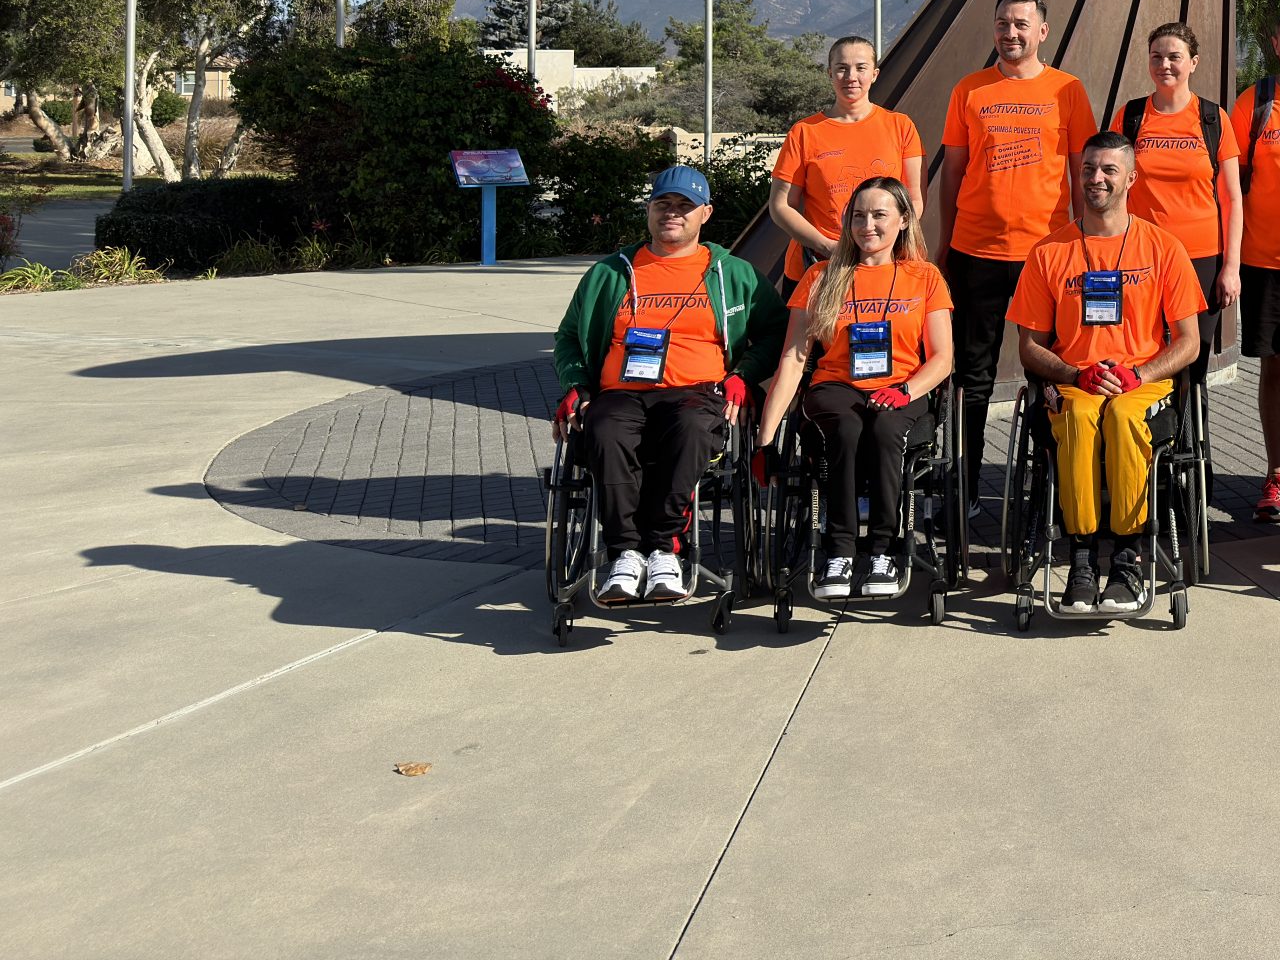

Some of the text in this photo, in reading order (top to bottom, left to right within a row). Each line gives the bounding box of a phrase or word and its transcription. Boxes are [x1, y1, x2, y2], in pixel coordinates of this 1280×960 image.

[979, 105, 1043, 115] MOTIVATION
[1013, 127, 1041, 135] POVESTEA
[839, 301, 910, 315] OTIVATON
